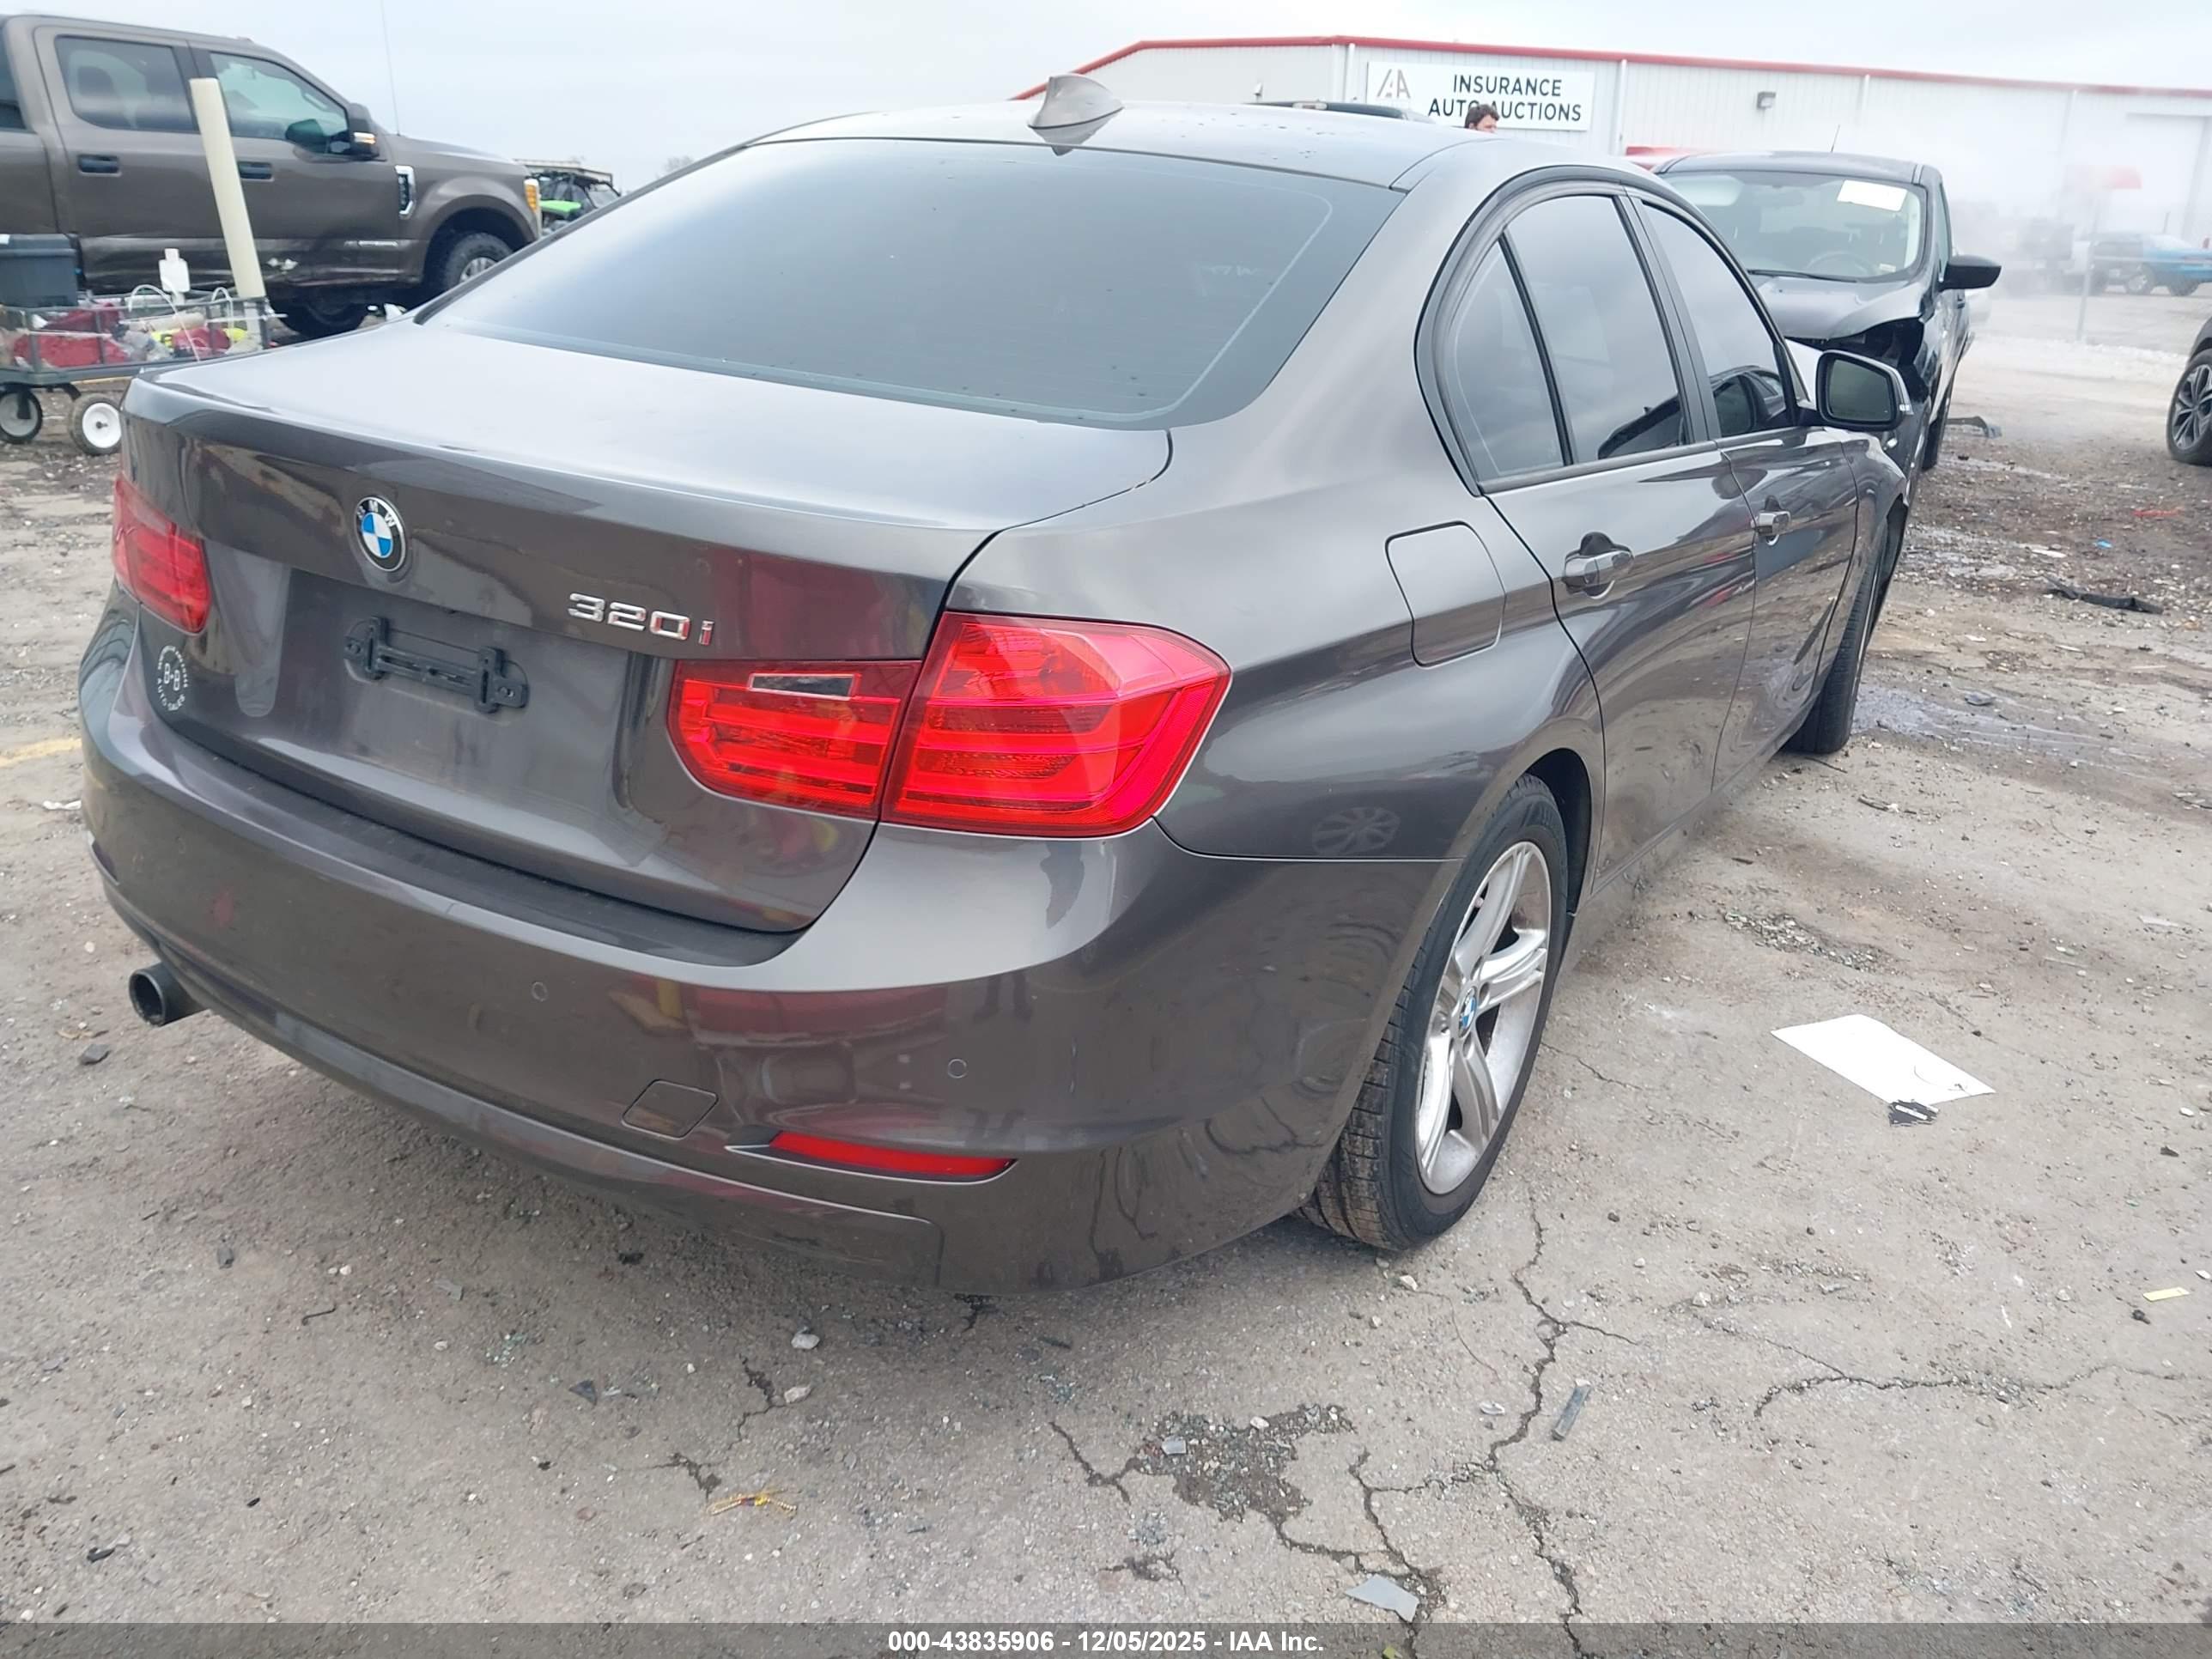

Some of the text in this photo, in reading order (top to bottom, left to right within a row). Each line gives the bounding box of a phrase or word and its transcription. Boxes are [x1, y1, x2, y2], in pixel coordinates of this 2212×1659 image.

[1453, 74, 1562, 96] INSURANCE
[357, 500, 395, 527] BMW
[568, 592, 715, 646] 320i
